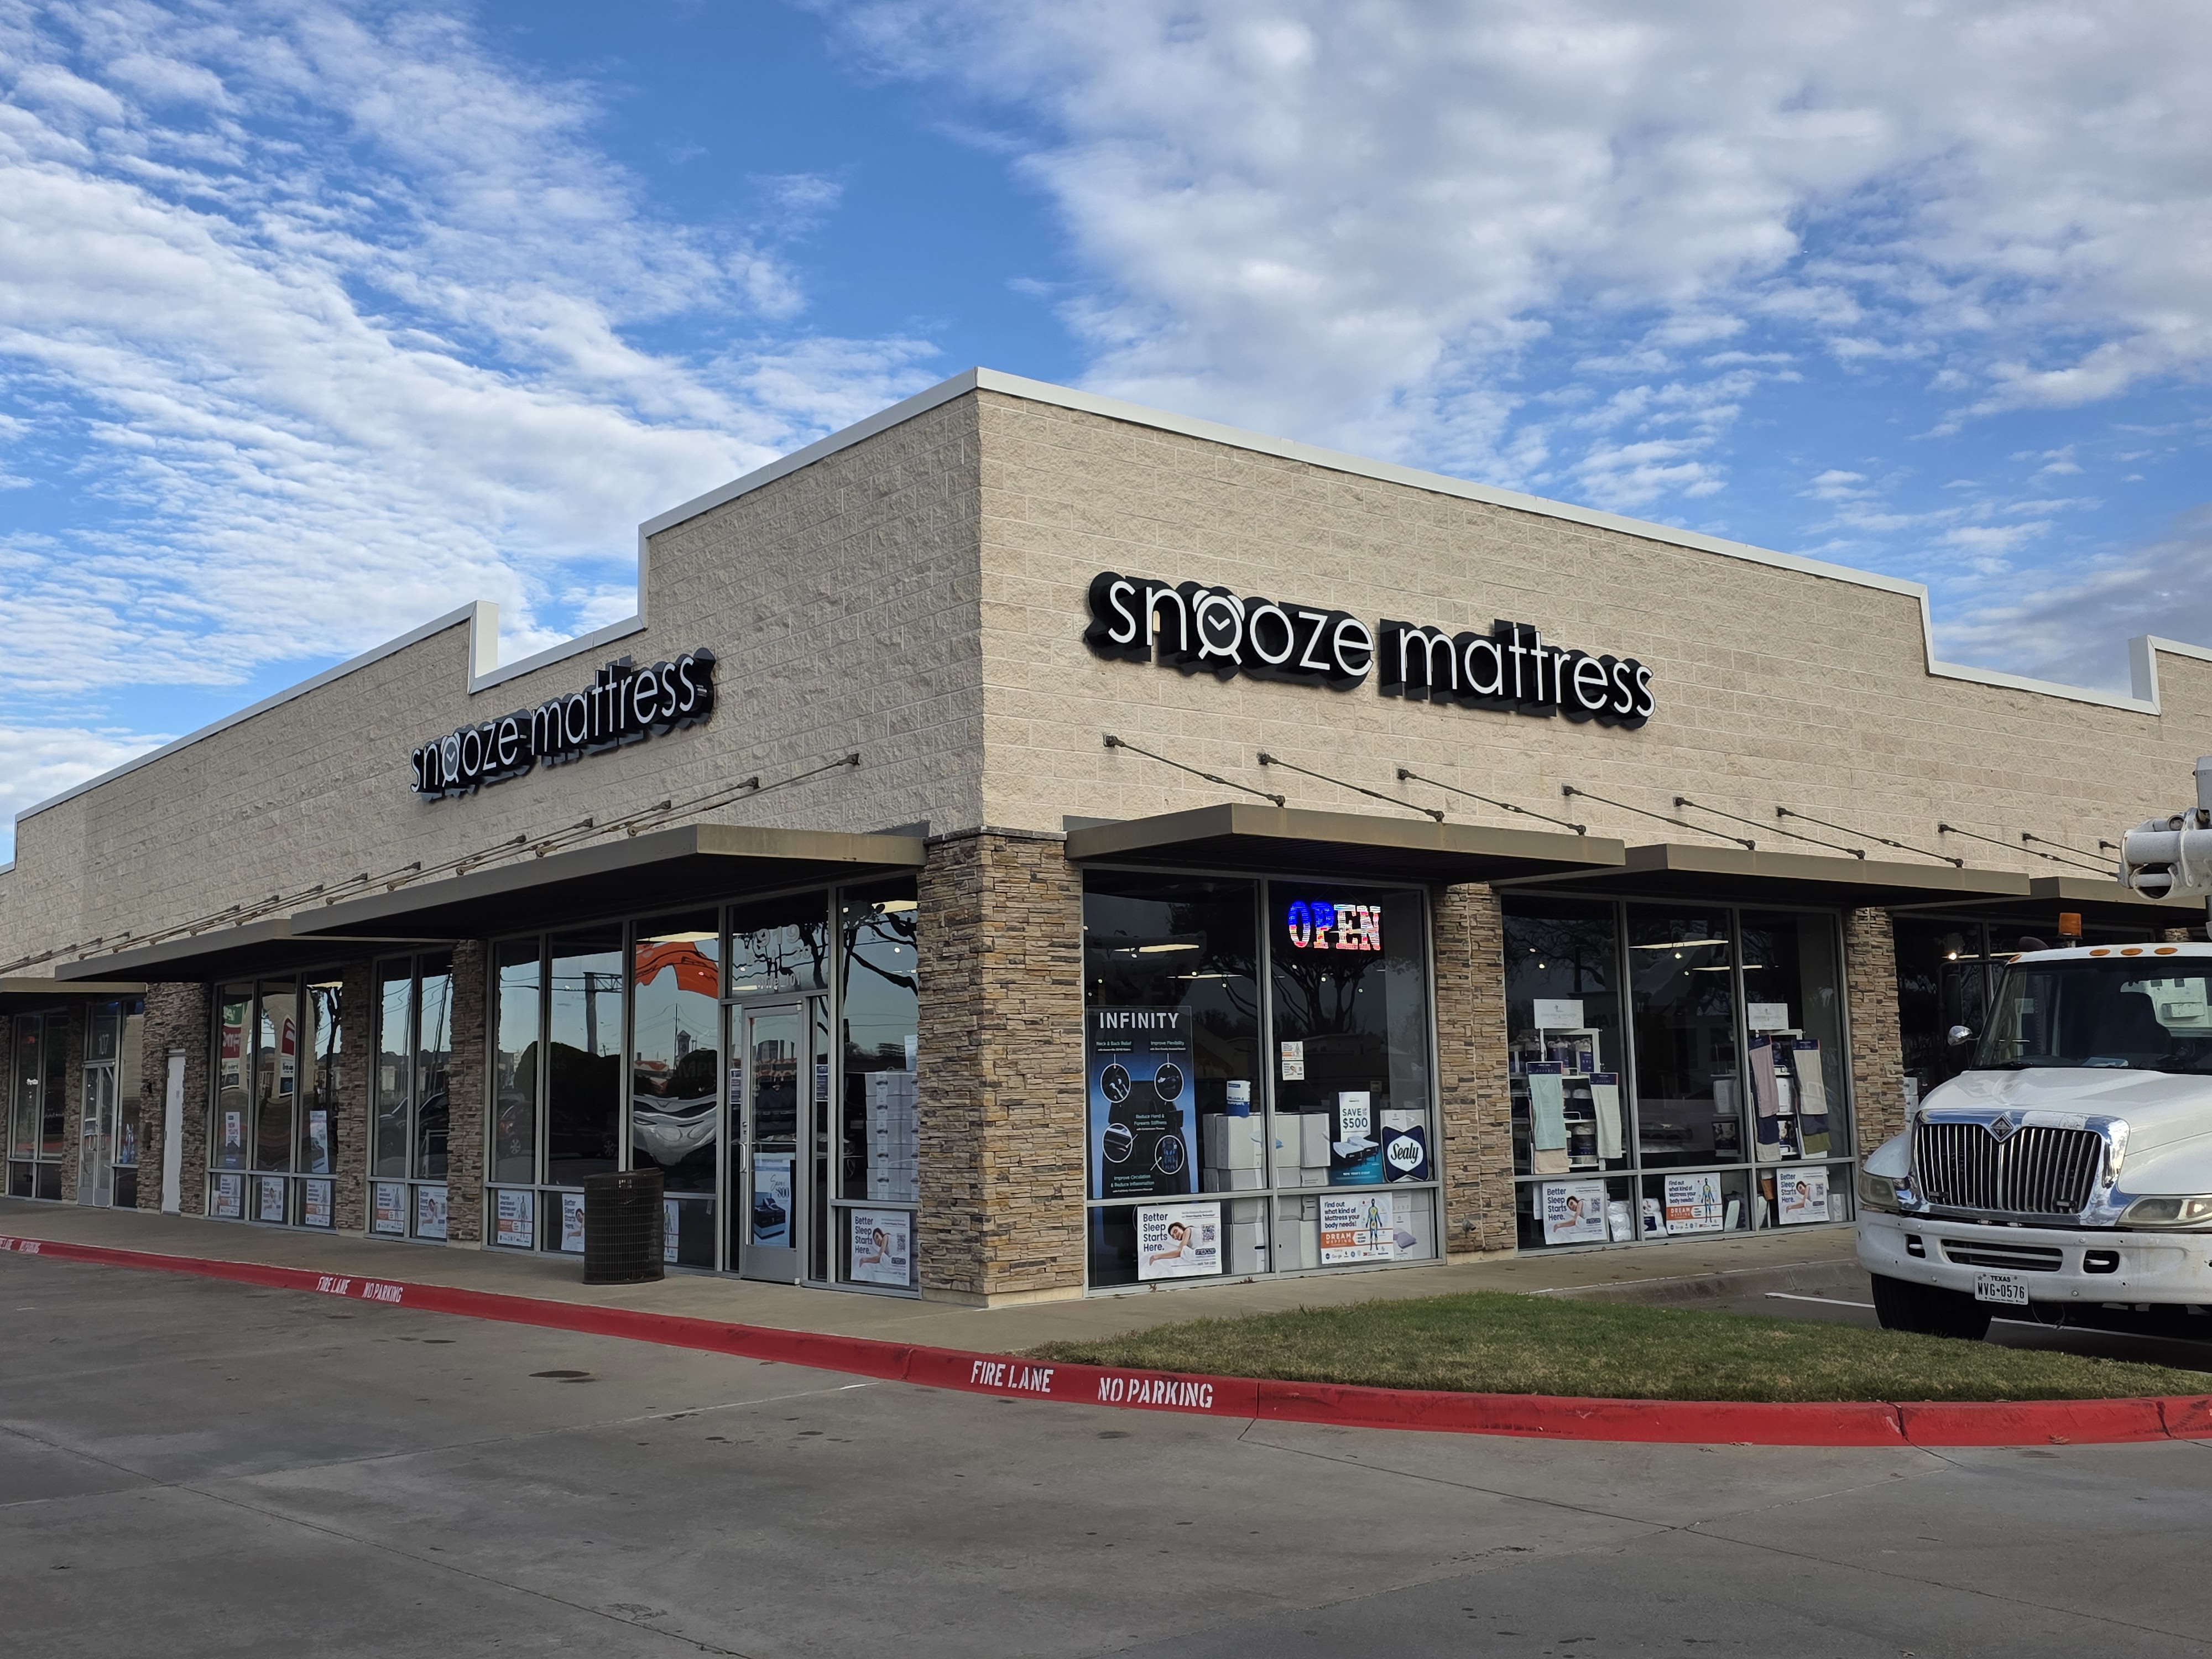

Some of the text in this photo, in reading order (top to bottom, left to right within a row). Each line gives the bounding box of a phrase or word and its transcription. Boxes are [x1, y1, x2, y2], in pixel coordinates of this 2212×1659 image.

[1109, 581, 1655, 718] snooze mattress
[410, 657, 695, 792] snooze mattress
[1288, 901, 1381, 951] OPEN
[757, 924, 800, 947] 919
[1100, 1013, 1180, 1029] INFINITY
[99, 1034, 109, 1055] 107
[1343, 1117, 1368, 1129] $500
[1391, 1142, 1419, 1164] Sealy
[1547, 1197, 1565, 1206] Sleep
[855, 1216, 873, 1225] Better
[1143, 1213, 1168, 1222] Better
[855, 1226, 872, 1236] Sleep
[1143, 1223, 1166, 1233] Sleep
[855, 1235, 873, 1245] Starts
[1143, 1233, 1168, 1242] Starts
[1144, 1244, 1164, 1252] Here.
[316, 1276, 351, 1295] FIRE LANE
[362, 1282, 403, 1303] NO PARKING
[971, 1361, 1054, 1392] FIRE LANE
[1098, 1377, 1213, 1408] NO PARKING
